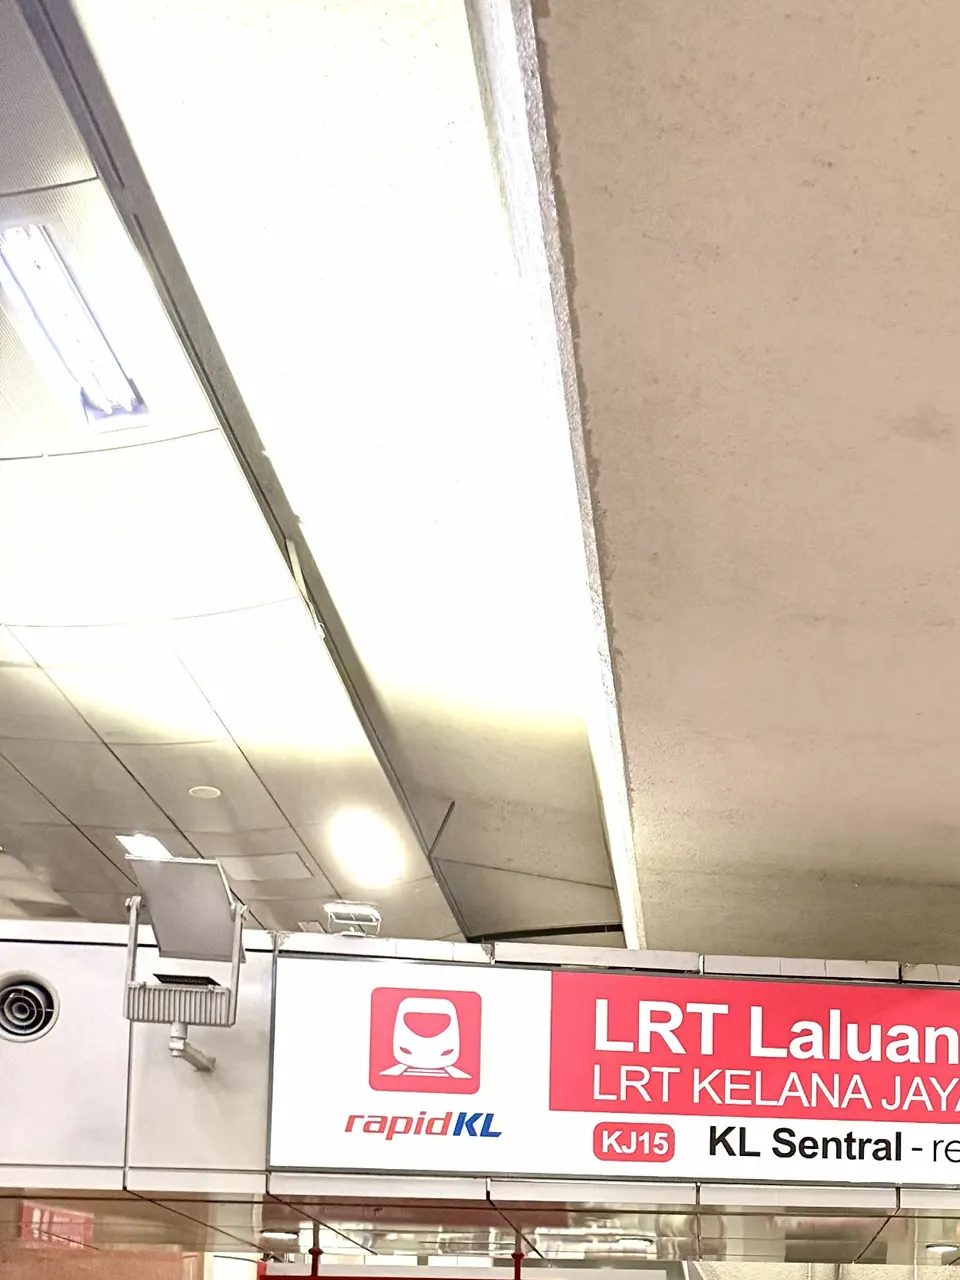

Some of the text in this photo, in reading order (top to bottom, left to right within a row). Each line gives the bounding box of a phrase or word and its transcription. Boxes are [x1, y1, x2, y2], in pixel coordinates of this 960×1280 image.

[594, 998, 730, 1056] LRT
[750, 1005, 959, 1066] Laluan
[593, 1064, 681, 1103] LRT
[692, 1068, 873, 1110] KELANA
[344, 1111, 503, 1140] rapidKL
[601, 1129, 669, 1156] KJ15
[709, 1126, 761, 1157] KL
[771, 1127, 902, 1162] Sentral
